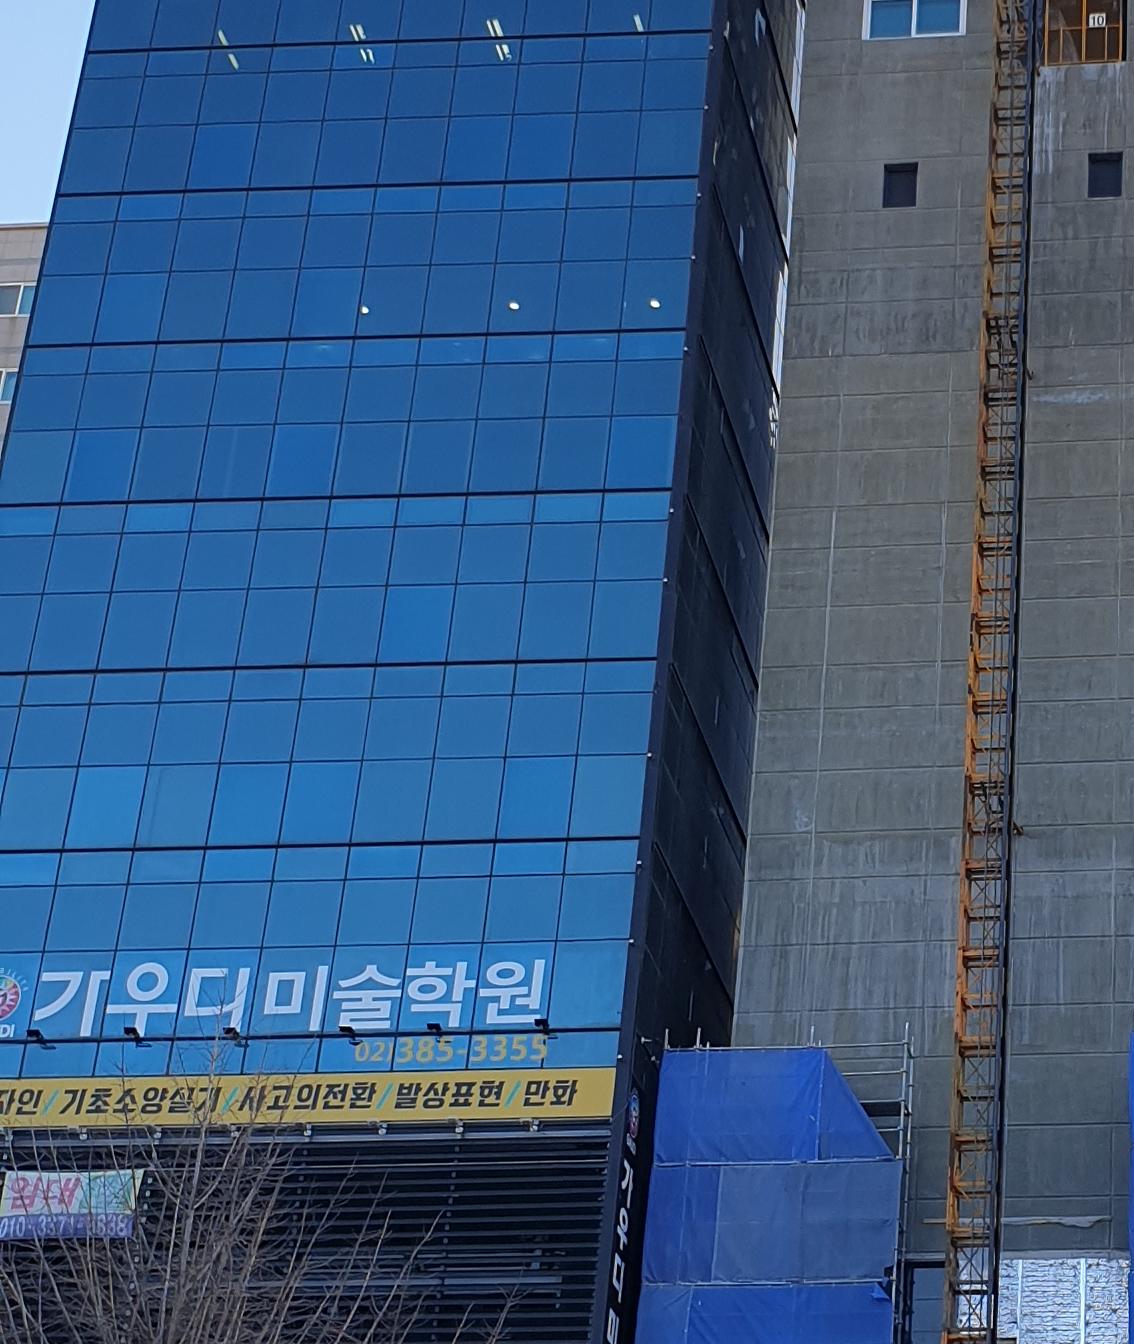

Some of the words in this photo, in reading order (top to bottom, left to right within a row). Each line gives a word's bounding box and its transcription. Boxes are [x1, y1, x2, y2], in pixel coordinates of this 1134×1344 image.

[32, 959, 546, 1037] 가우디미술학원
[394, 1080, 505, 1109] 발상표현
[523, 1079, 578, 1106] 만화
